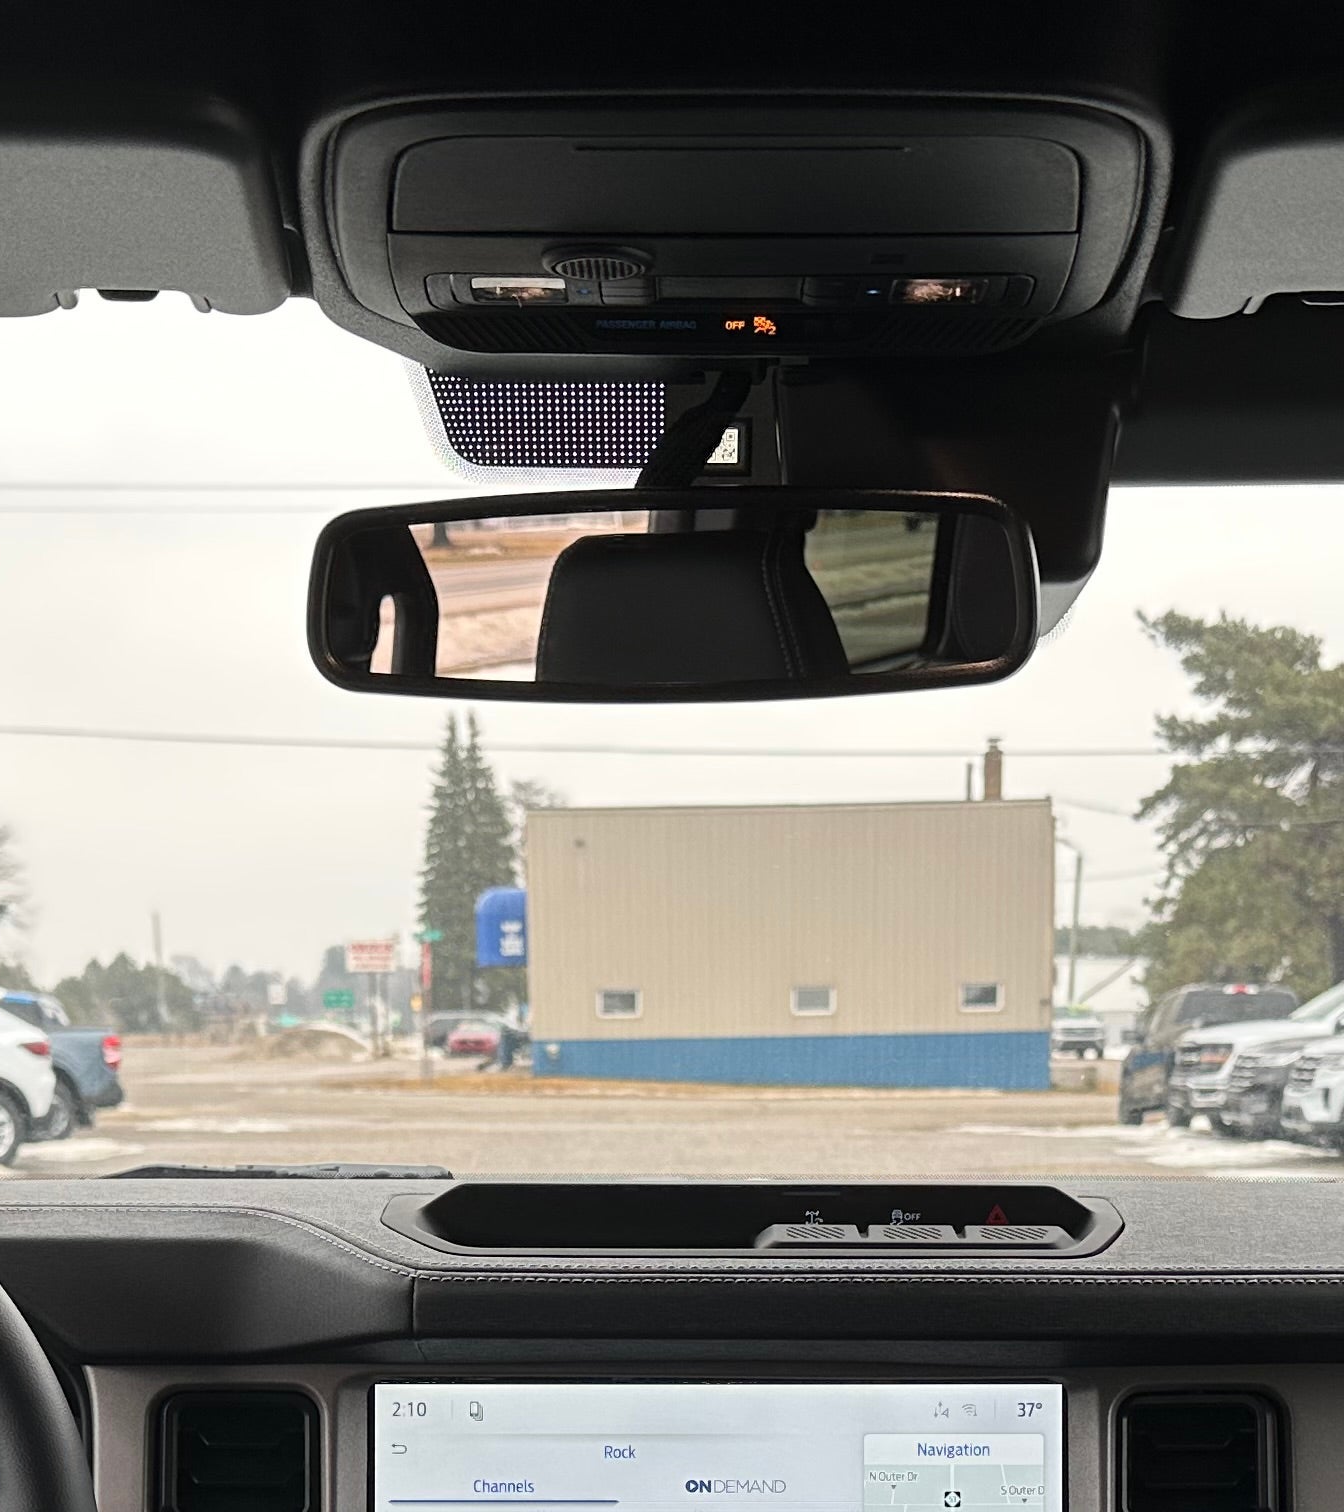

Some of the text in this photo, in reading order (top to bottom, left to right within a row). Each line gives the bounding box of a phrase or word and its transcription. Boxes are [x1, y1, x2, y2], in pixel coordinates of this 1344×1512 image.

[596, 320, 696, 330] PASSENGER AIRBAG
[725, 321, 745, 330] OFF
[904, 1213, 921, 1221] OFF
[391, 1402, 428, 1418] 2:10
[1017, 1402, 1043, 1417] 37°
[604, 1445, 637, 1460] Rock
[917, 1443, 991, 1459] Navigation
[869, 1472, 918, 1481] N Outer Dr
[473, 1479, 535, 1494] Channels
[1008, 1486, 1036, 1495] Outer
